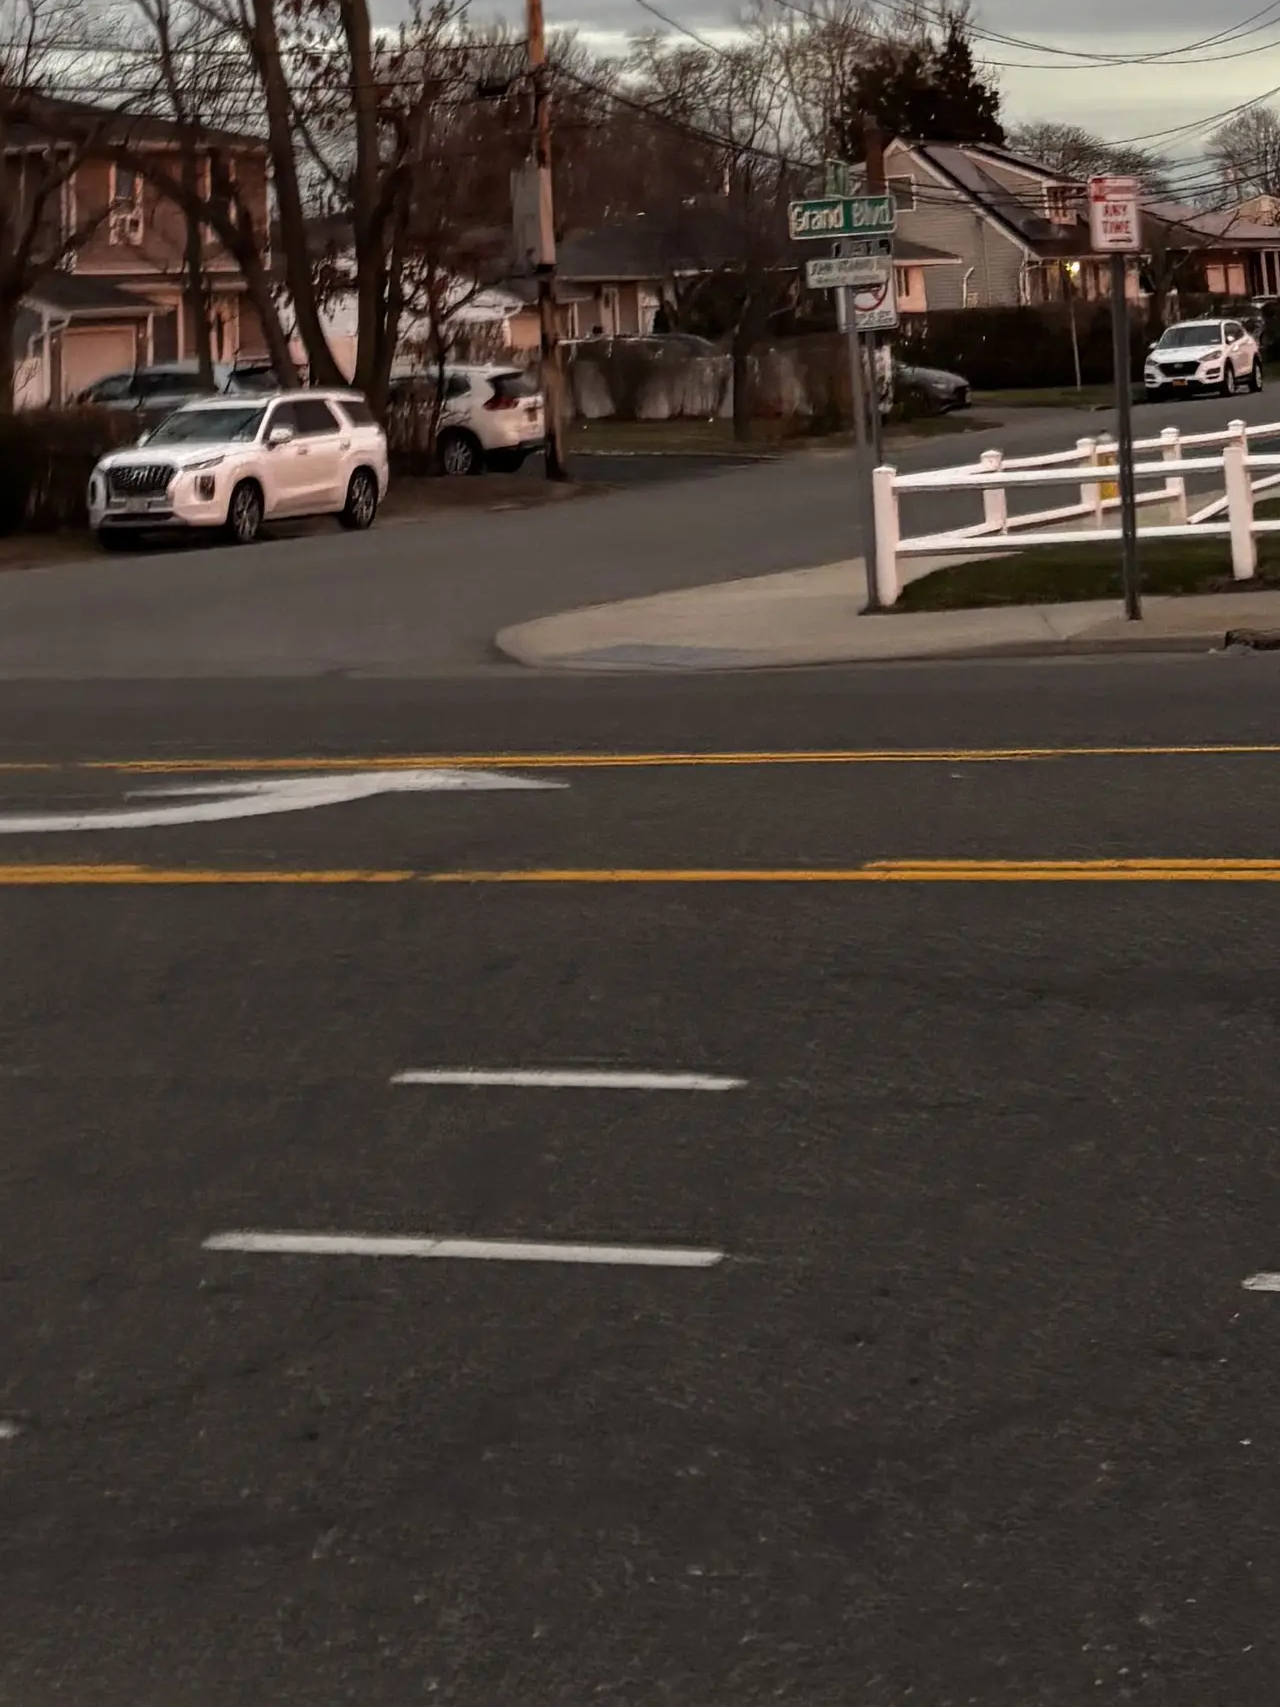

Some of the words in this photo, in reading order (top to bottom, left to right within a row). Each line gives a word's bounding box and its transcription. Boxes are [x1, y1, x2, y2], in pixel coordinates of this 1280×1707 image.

[792, 201, 844, 231] Grand
[851, 199, 890, 227] Blvd
[1103, 204, 1128, 217] ANY
[1102, 220, 1132, 235] TIME
